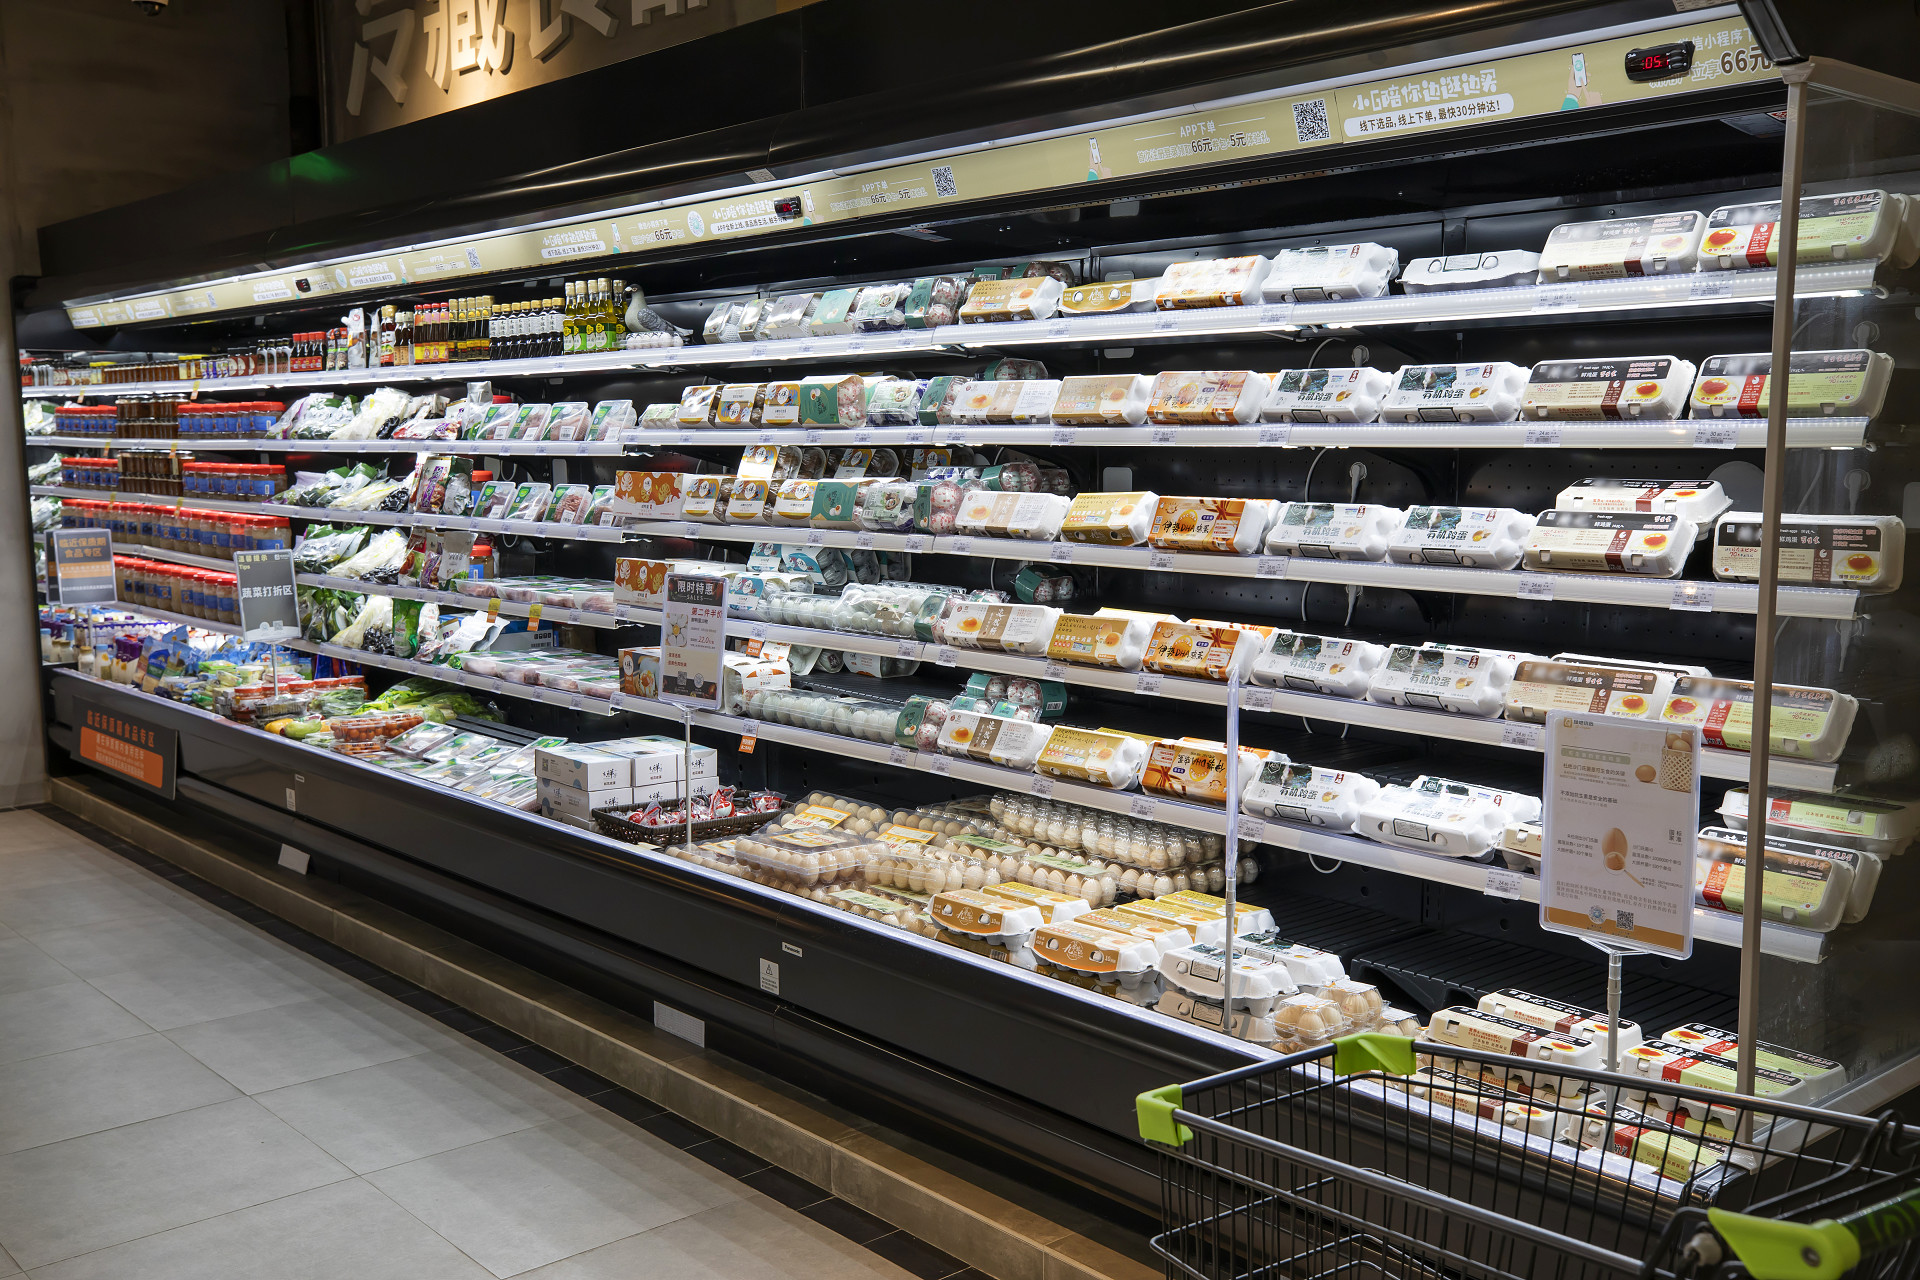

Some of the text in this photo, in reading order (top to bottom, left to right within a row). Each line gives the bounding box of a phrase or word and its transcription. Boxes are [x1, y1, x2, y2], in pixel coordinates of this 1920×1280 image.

[1352, 68, 1497, 112] 小G陪你边逛边买
[1180, 120, 1216, 138] APP下单
[1297, 391, 1334, 402] 有机鸡蛋
[1422, 388, 1466, 400] 有机鸡蛋
[1302, 526, 1341, 538] 有机鸡蛋
[1426, 530, 1469, 541] 有机鸡蛋
[242, 585, 293, 599] 蔬菜打折区
[677, 580, 713, 596] 限时特惠
[1289, 658, 1326, 673] 有机鸡蛋
[1409, 673, 1452, 687] 有机鸡蛋
[1279, 786, 1317, 800] 有机鸡蛋
